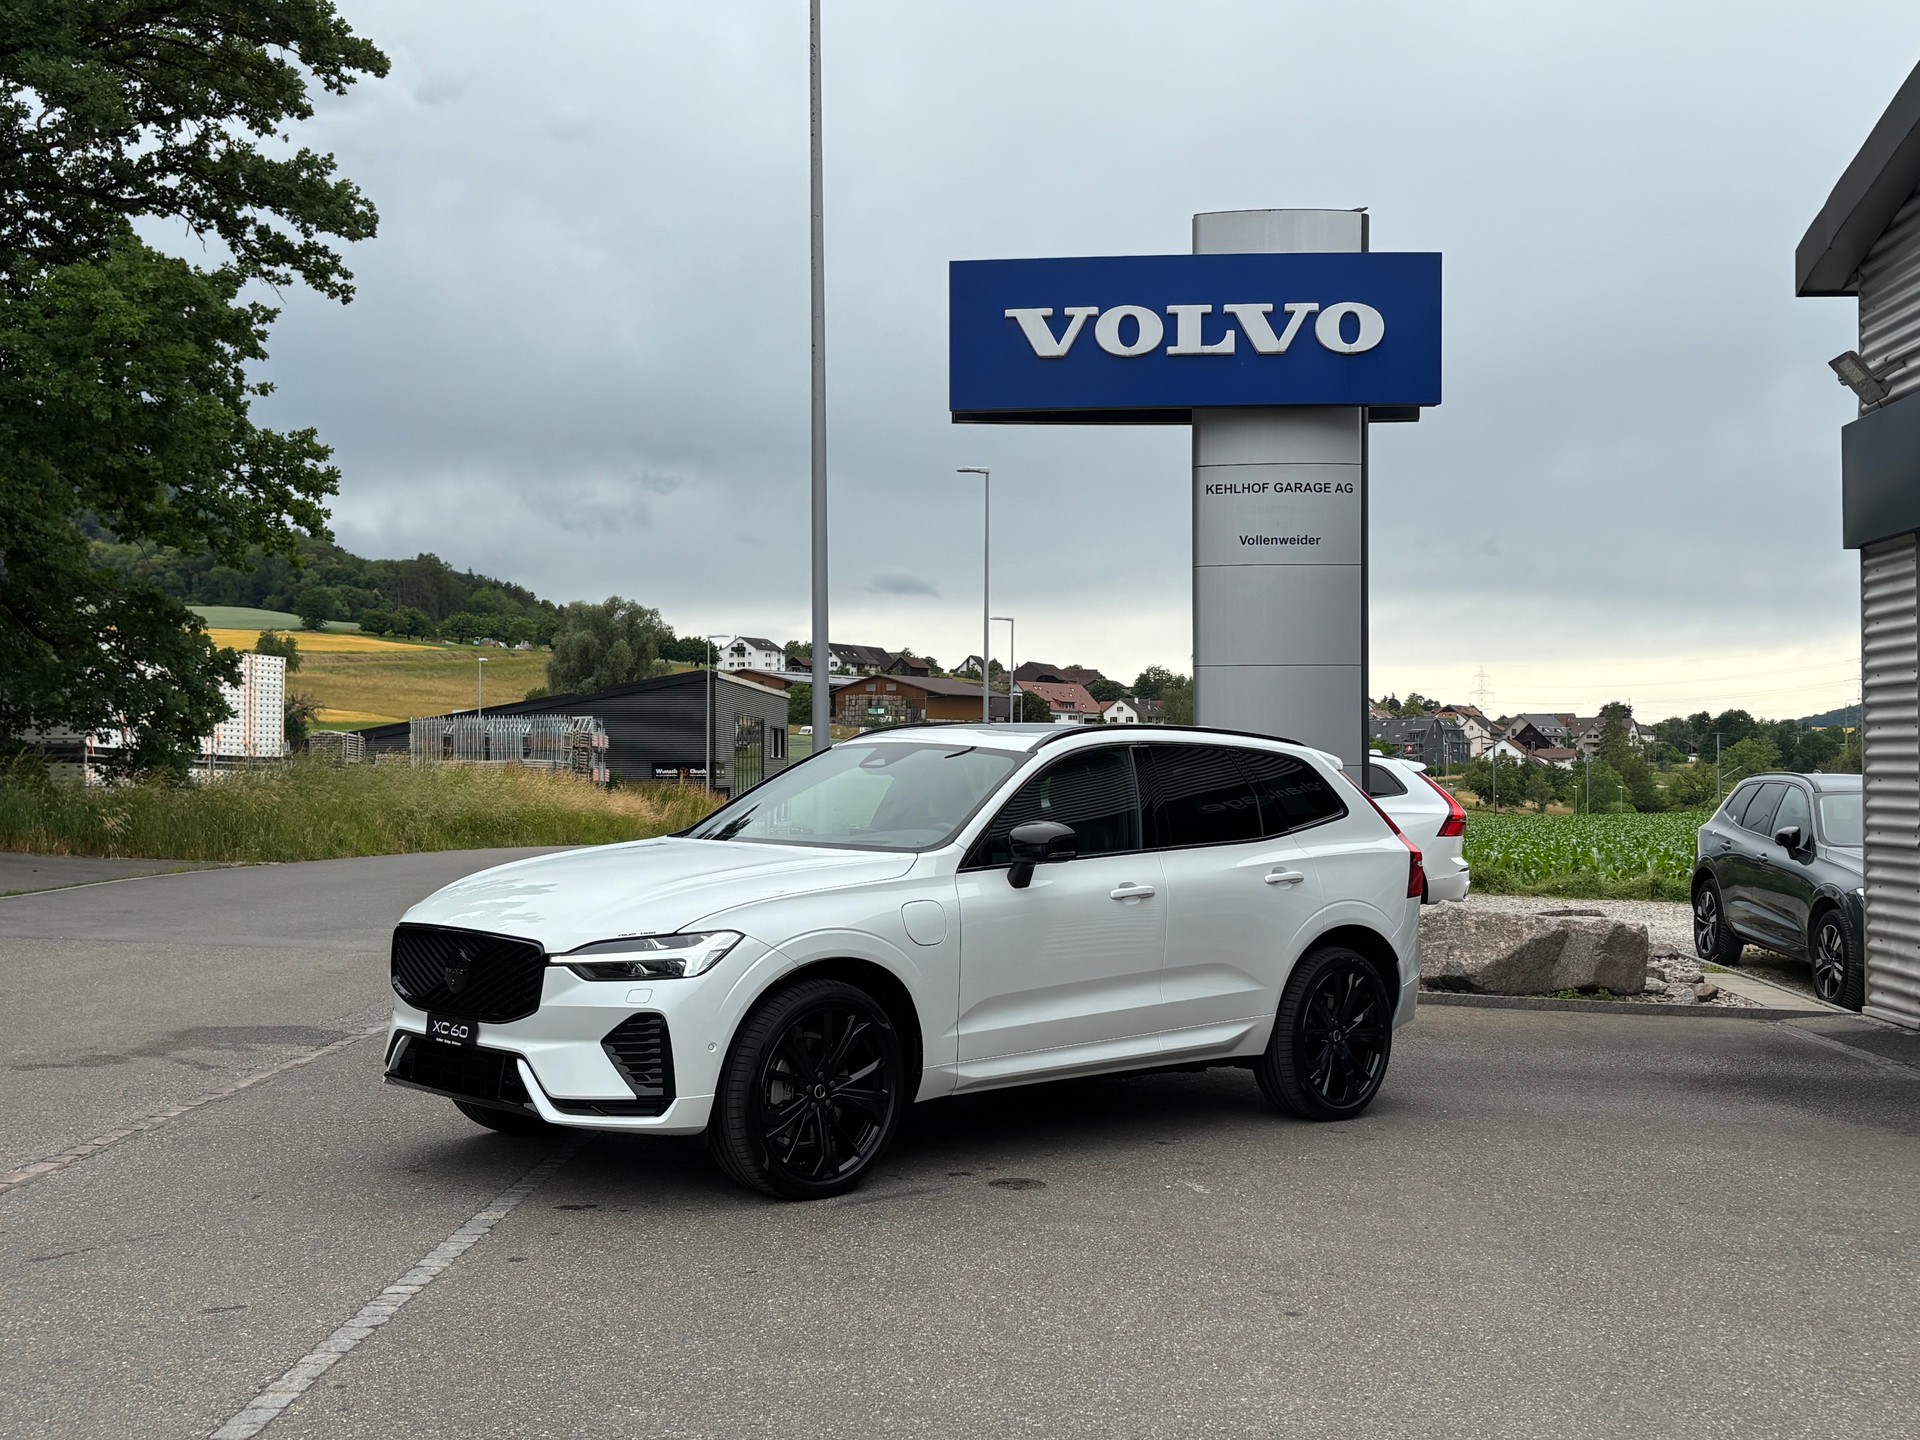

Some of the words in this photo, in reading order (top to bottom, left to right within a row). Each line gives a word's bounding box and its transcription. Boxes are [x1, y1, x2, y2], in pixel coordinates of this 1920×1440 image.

[1004, 302, 1385, 358] VOLVO
[1205, 482, 1270, 495] KEHLHOF
[1273, 482, 1332, 494] GARAGE
[1335, 482, 1354, 494] AG
[1239, 535, 1321, 546] Vollenweider
